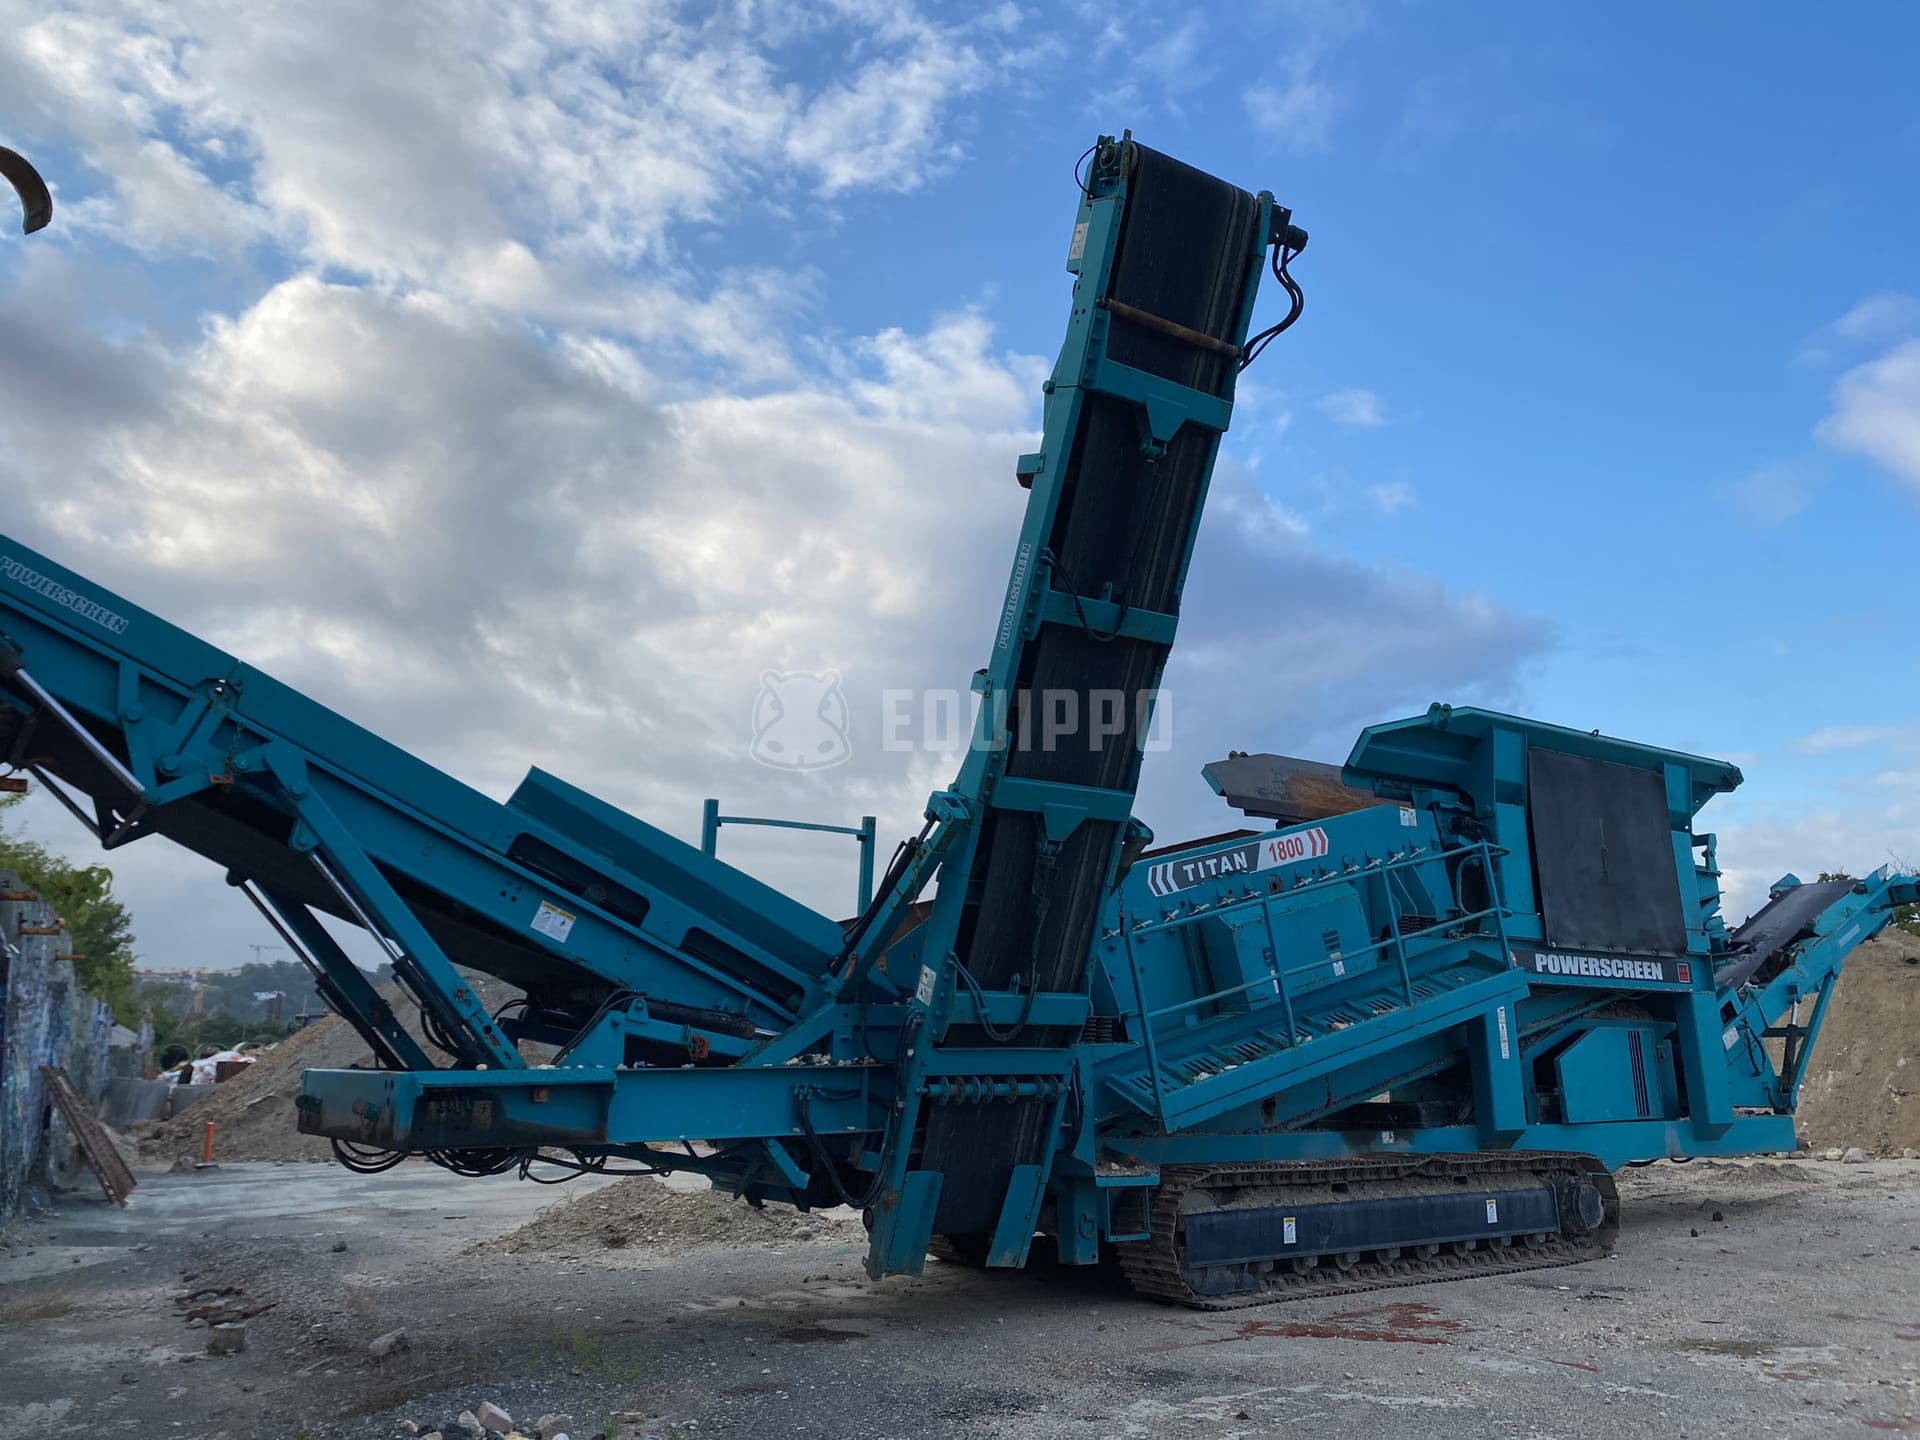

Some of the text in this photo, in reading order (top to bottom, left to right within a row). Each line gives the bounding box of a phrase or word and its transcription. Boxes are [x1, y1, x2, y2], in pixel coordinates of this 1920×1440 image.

[998, 544, 1031, 649] POWERSCREEN
[1183, 837, 1304, 882] TITAN 1800
[1535, 953, 1663, 980] POWERSCREEN
